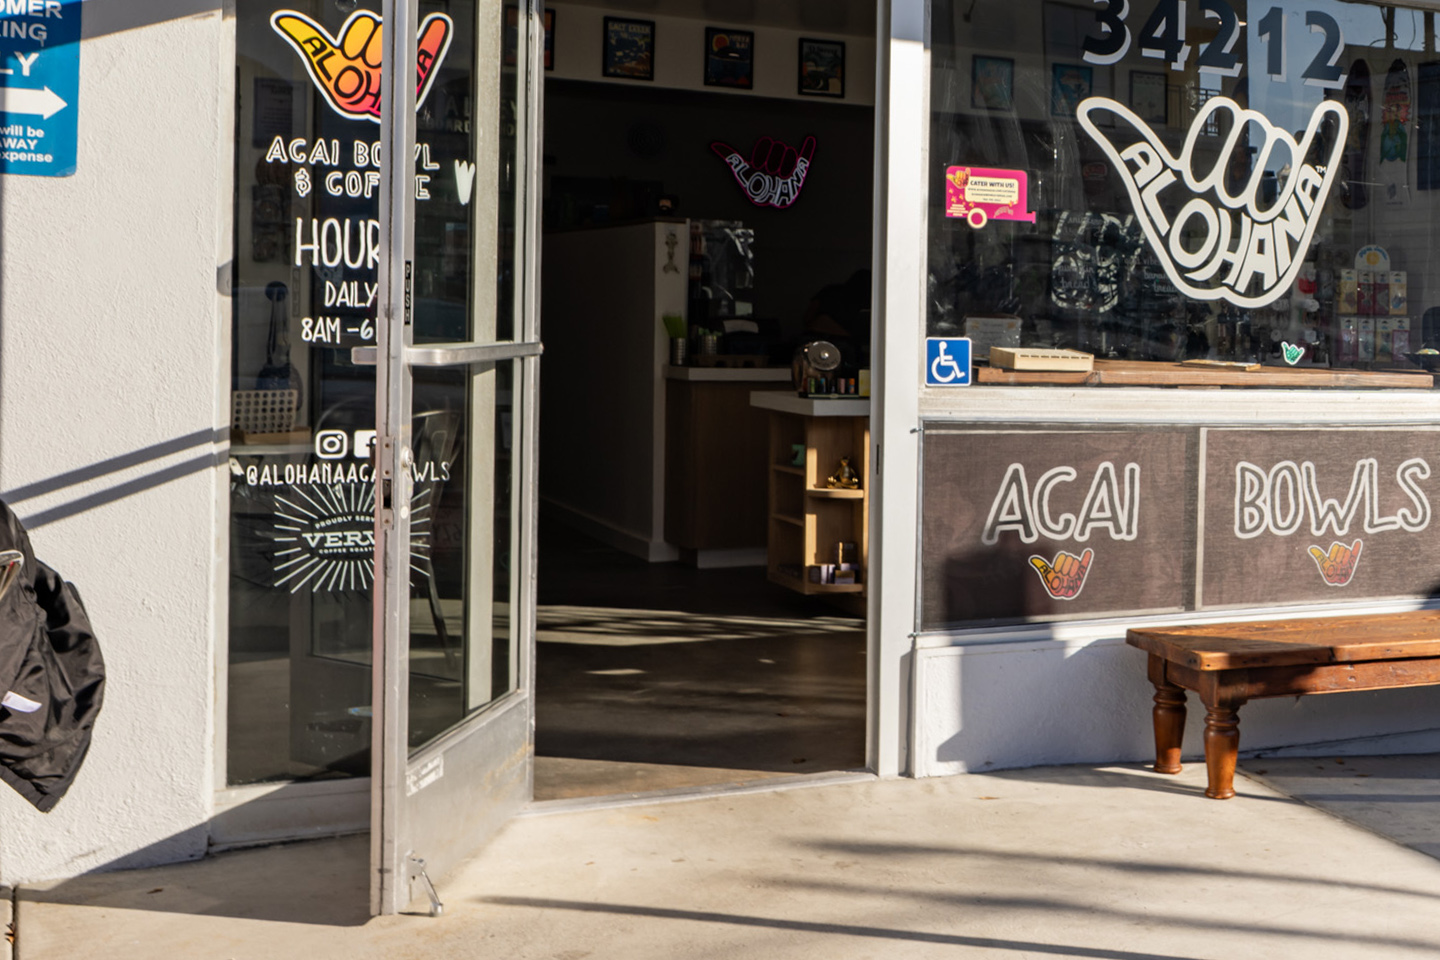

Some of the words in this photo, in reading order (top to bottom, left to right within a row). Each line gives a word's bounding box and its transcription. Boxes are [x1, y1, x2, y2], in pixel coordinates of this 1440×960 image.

[0, 20, 48, 41] ING
[27, 126, 45, 138] be
[266, 135, 340, 166] ACAI
[725, 152, 810, 207] ALOHANA
[1120, 142, 1324, 292] ALOHANA
[324, 280, 379, 308] DAILY
[301, 316, 341, 344] 8AM
[981, 462, 1141, 545] ACAI
[1234, 457, 1432, 539] BOWLS
[315, 515, 352, 529] PROUDLY
